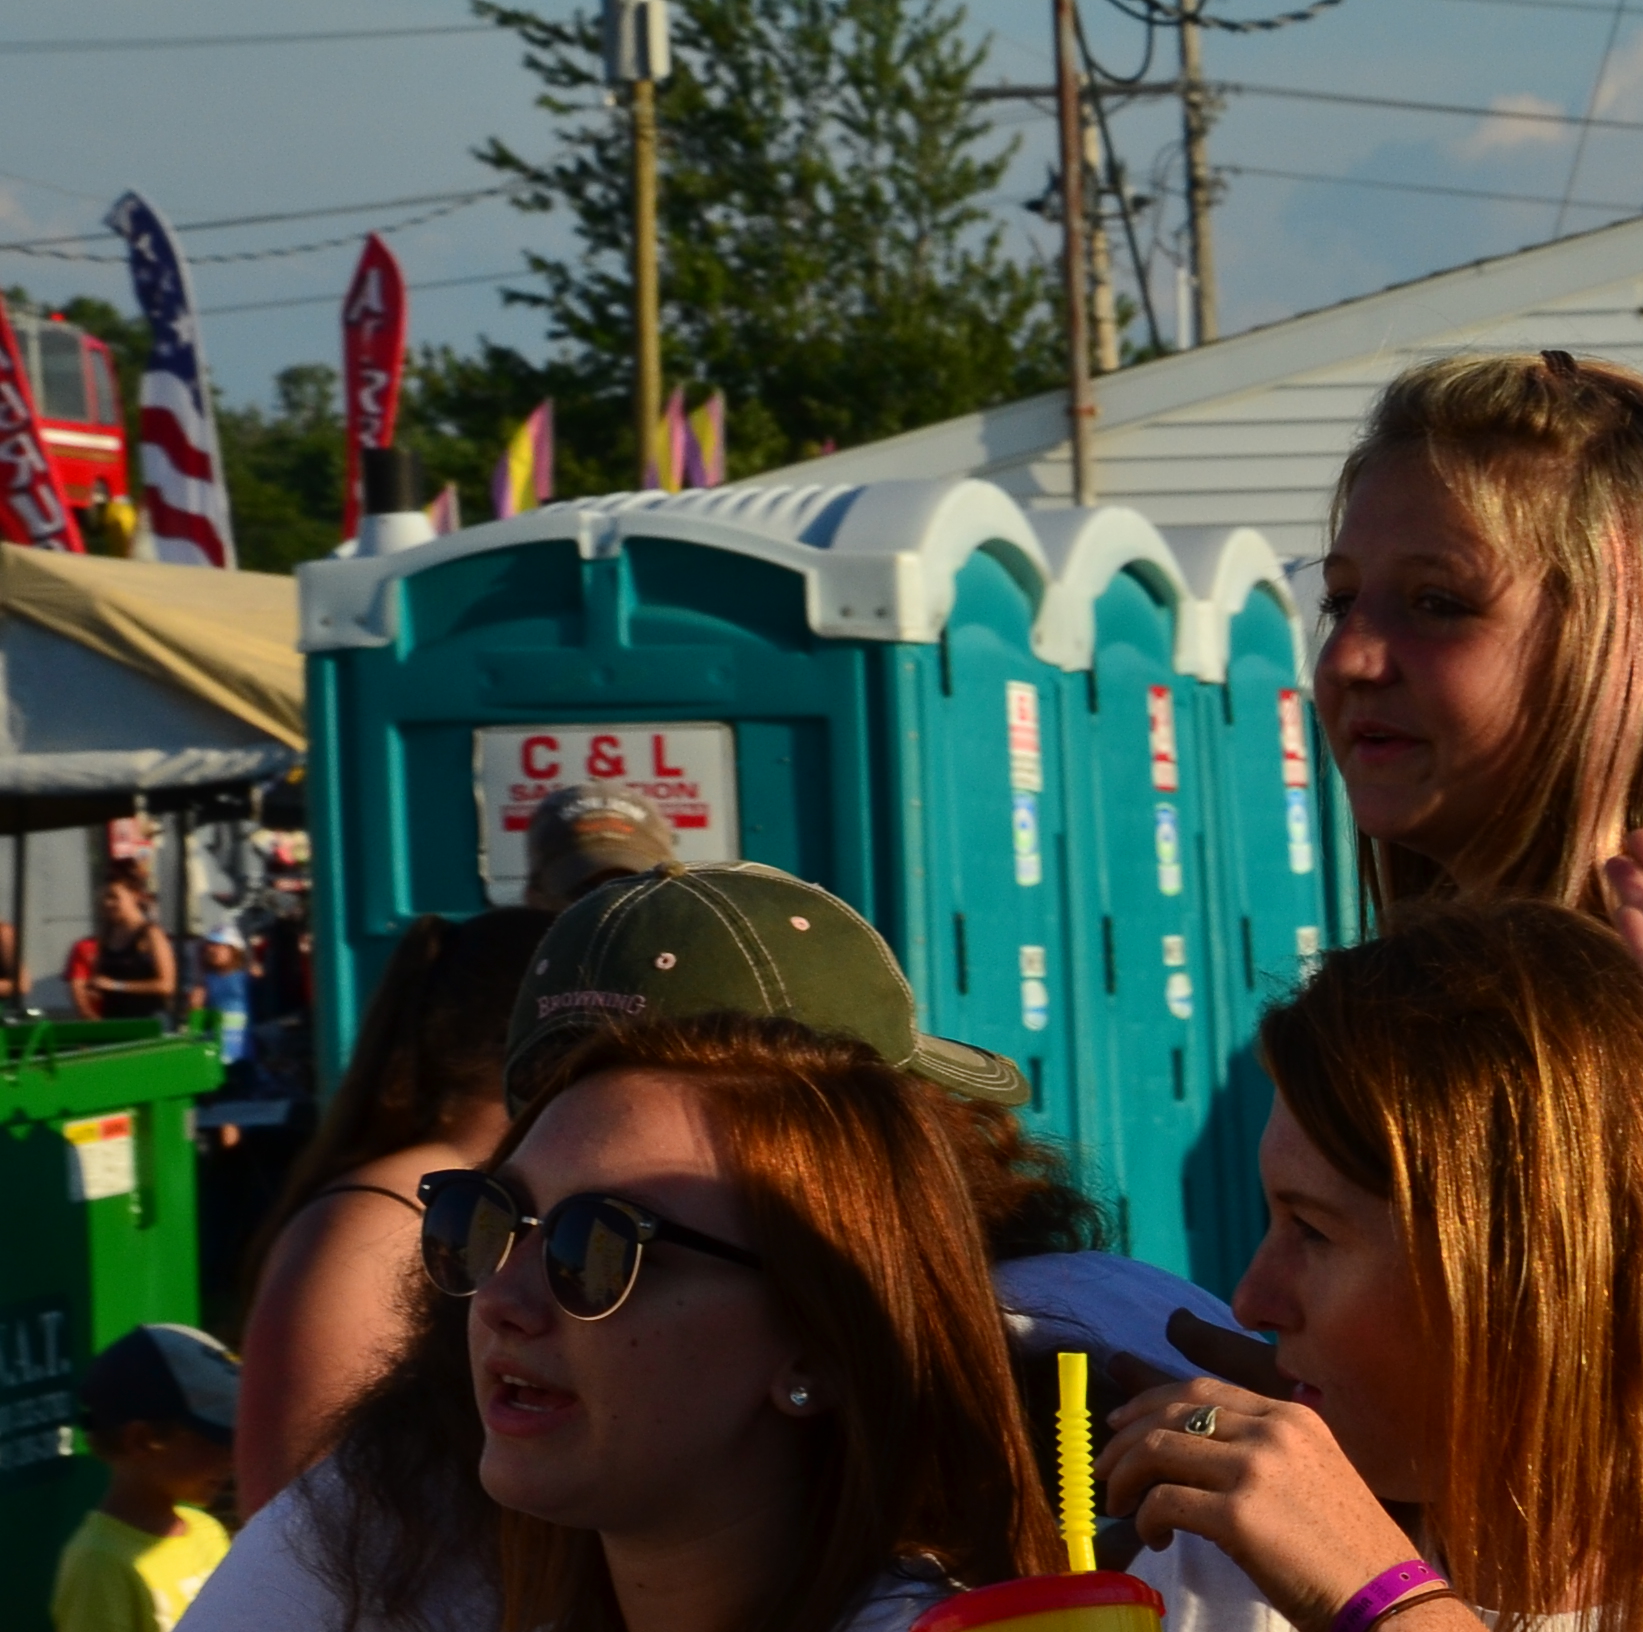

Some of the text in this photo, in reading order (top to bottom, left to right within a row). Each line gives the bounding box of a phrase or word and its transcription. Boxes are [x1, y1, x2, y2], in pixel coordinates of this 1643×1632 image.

[522, 734, 683, 778] C & L
[537, 990, 646, 1019] BROWNING
